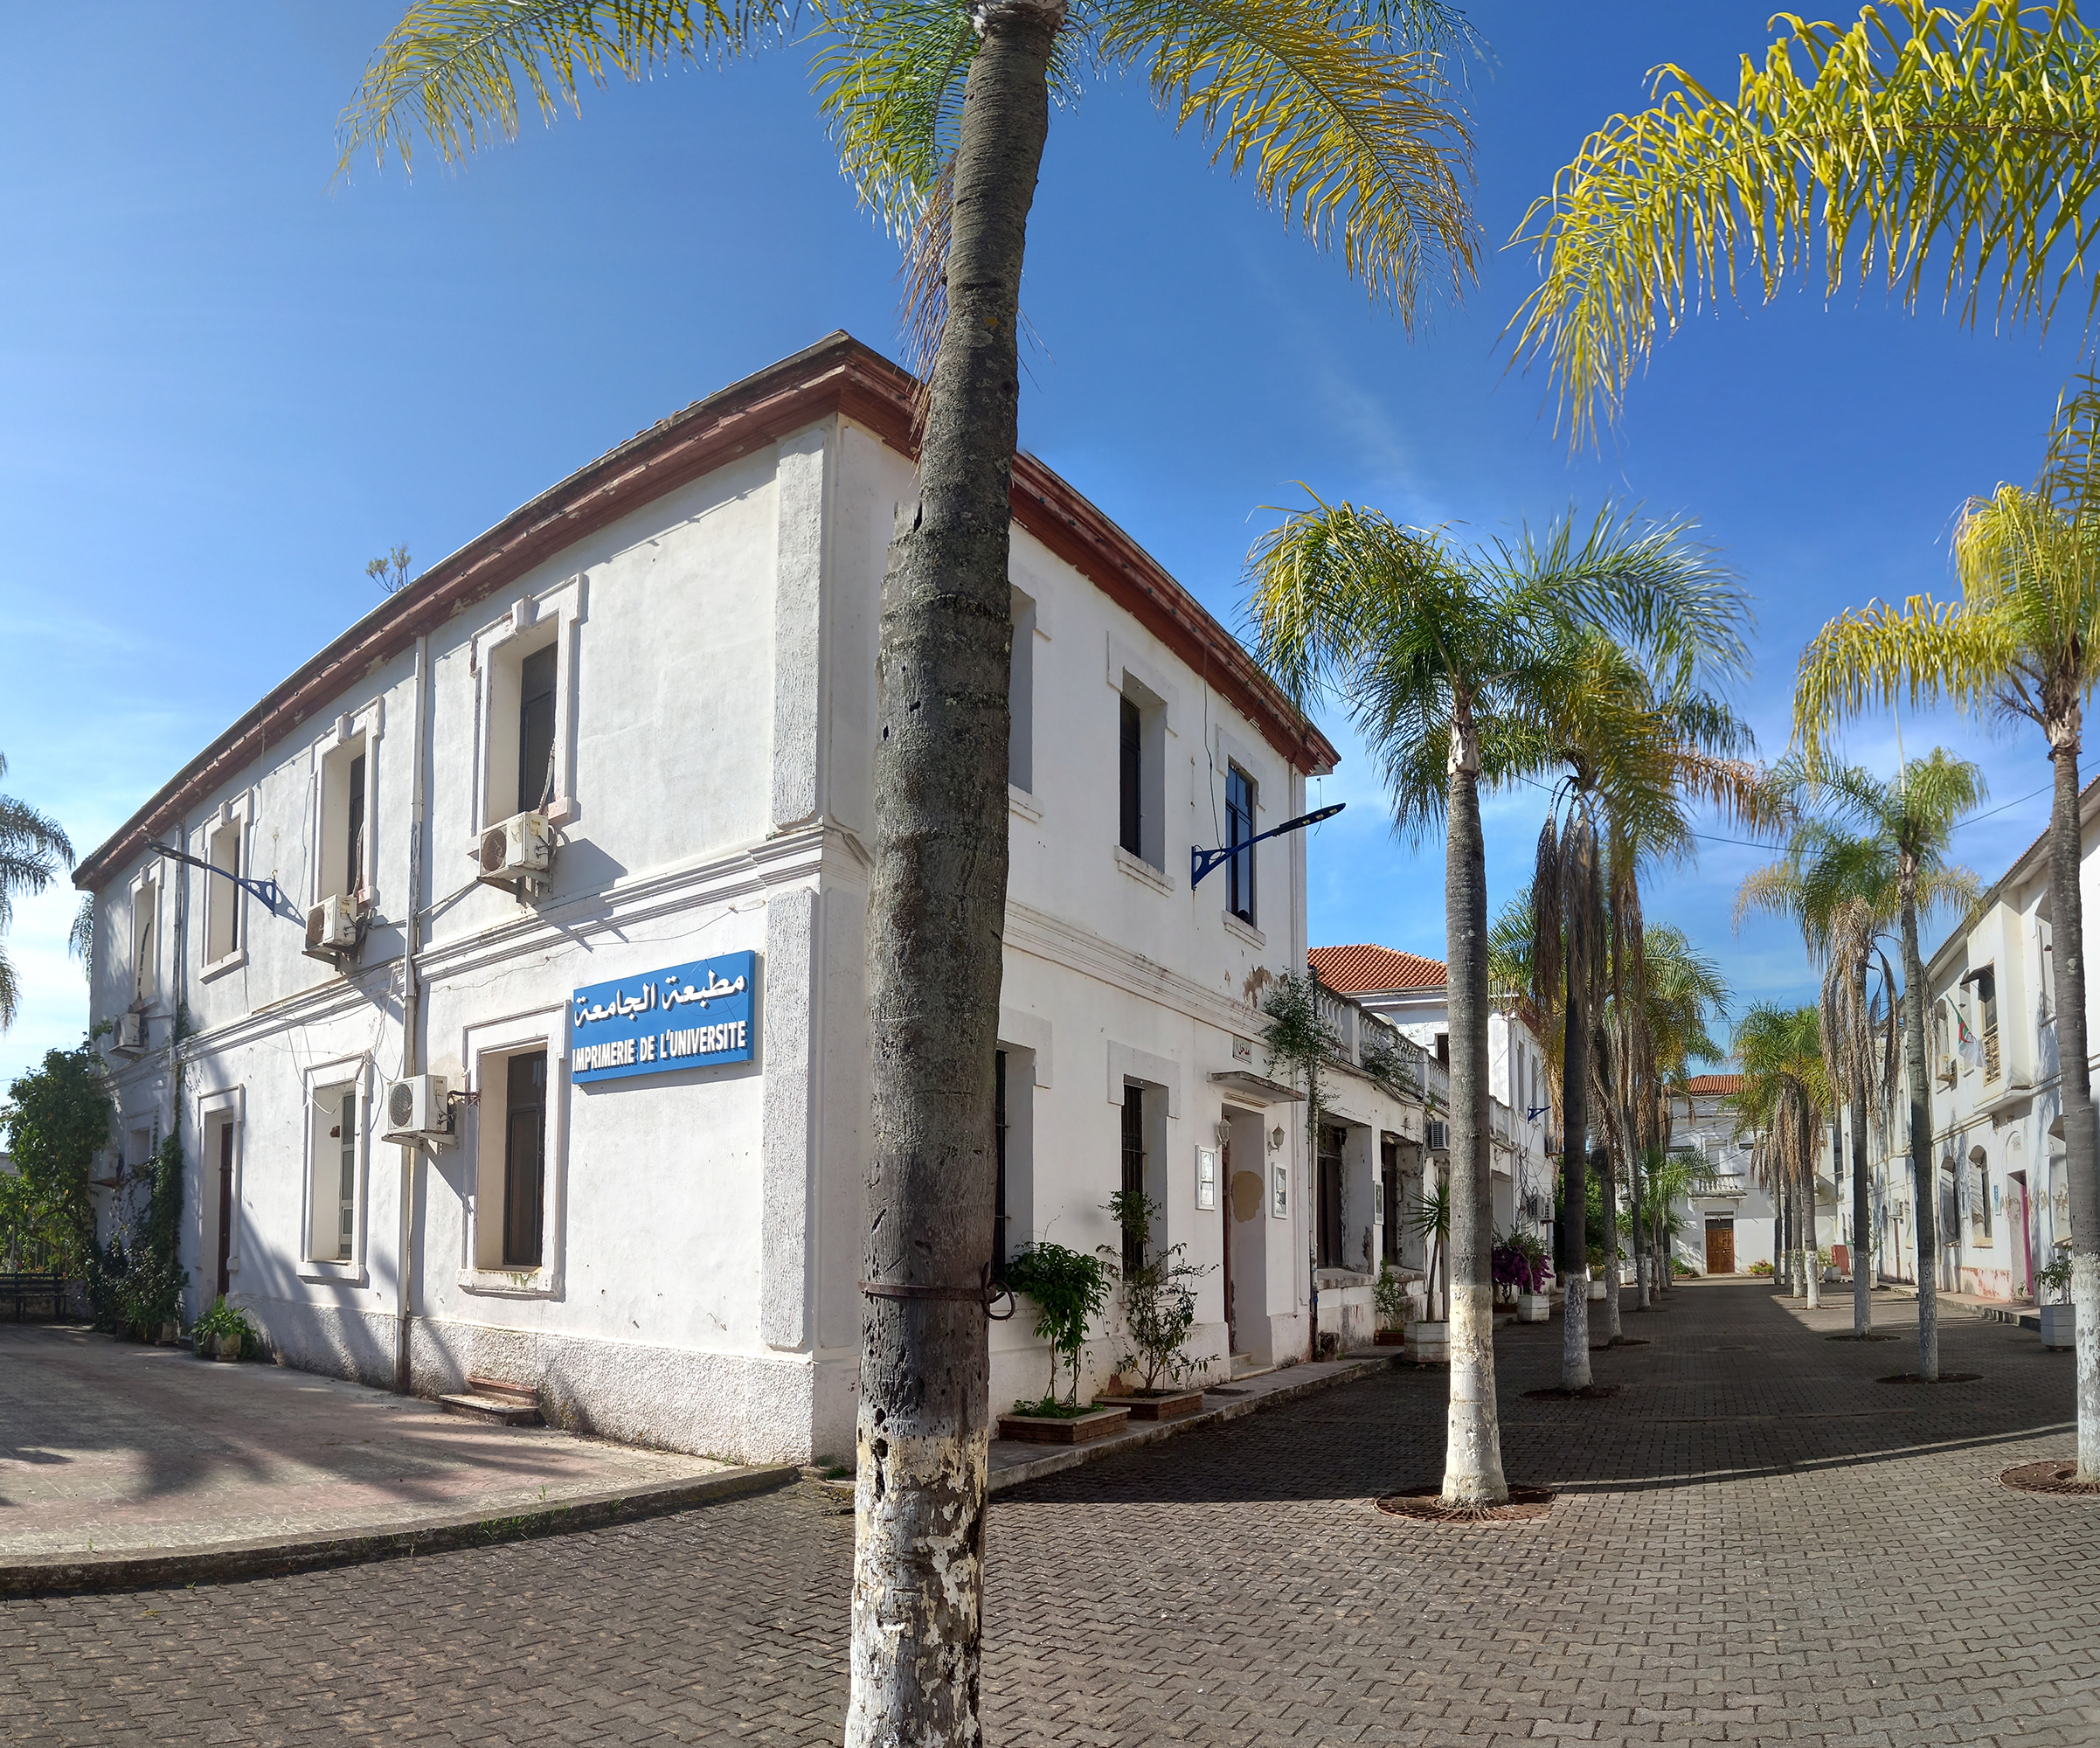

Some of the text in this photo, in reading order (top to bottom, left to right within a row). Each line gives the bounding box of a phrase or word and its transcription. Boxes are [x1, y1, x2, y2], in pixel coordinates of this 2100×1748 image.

[574, 970, 748, 1028] مطبعة الجامعة
[572, 1020, 747, 1072] IMPRIMERIE DE L'UNIVERSITE
